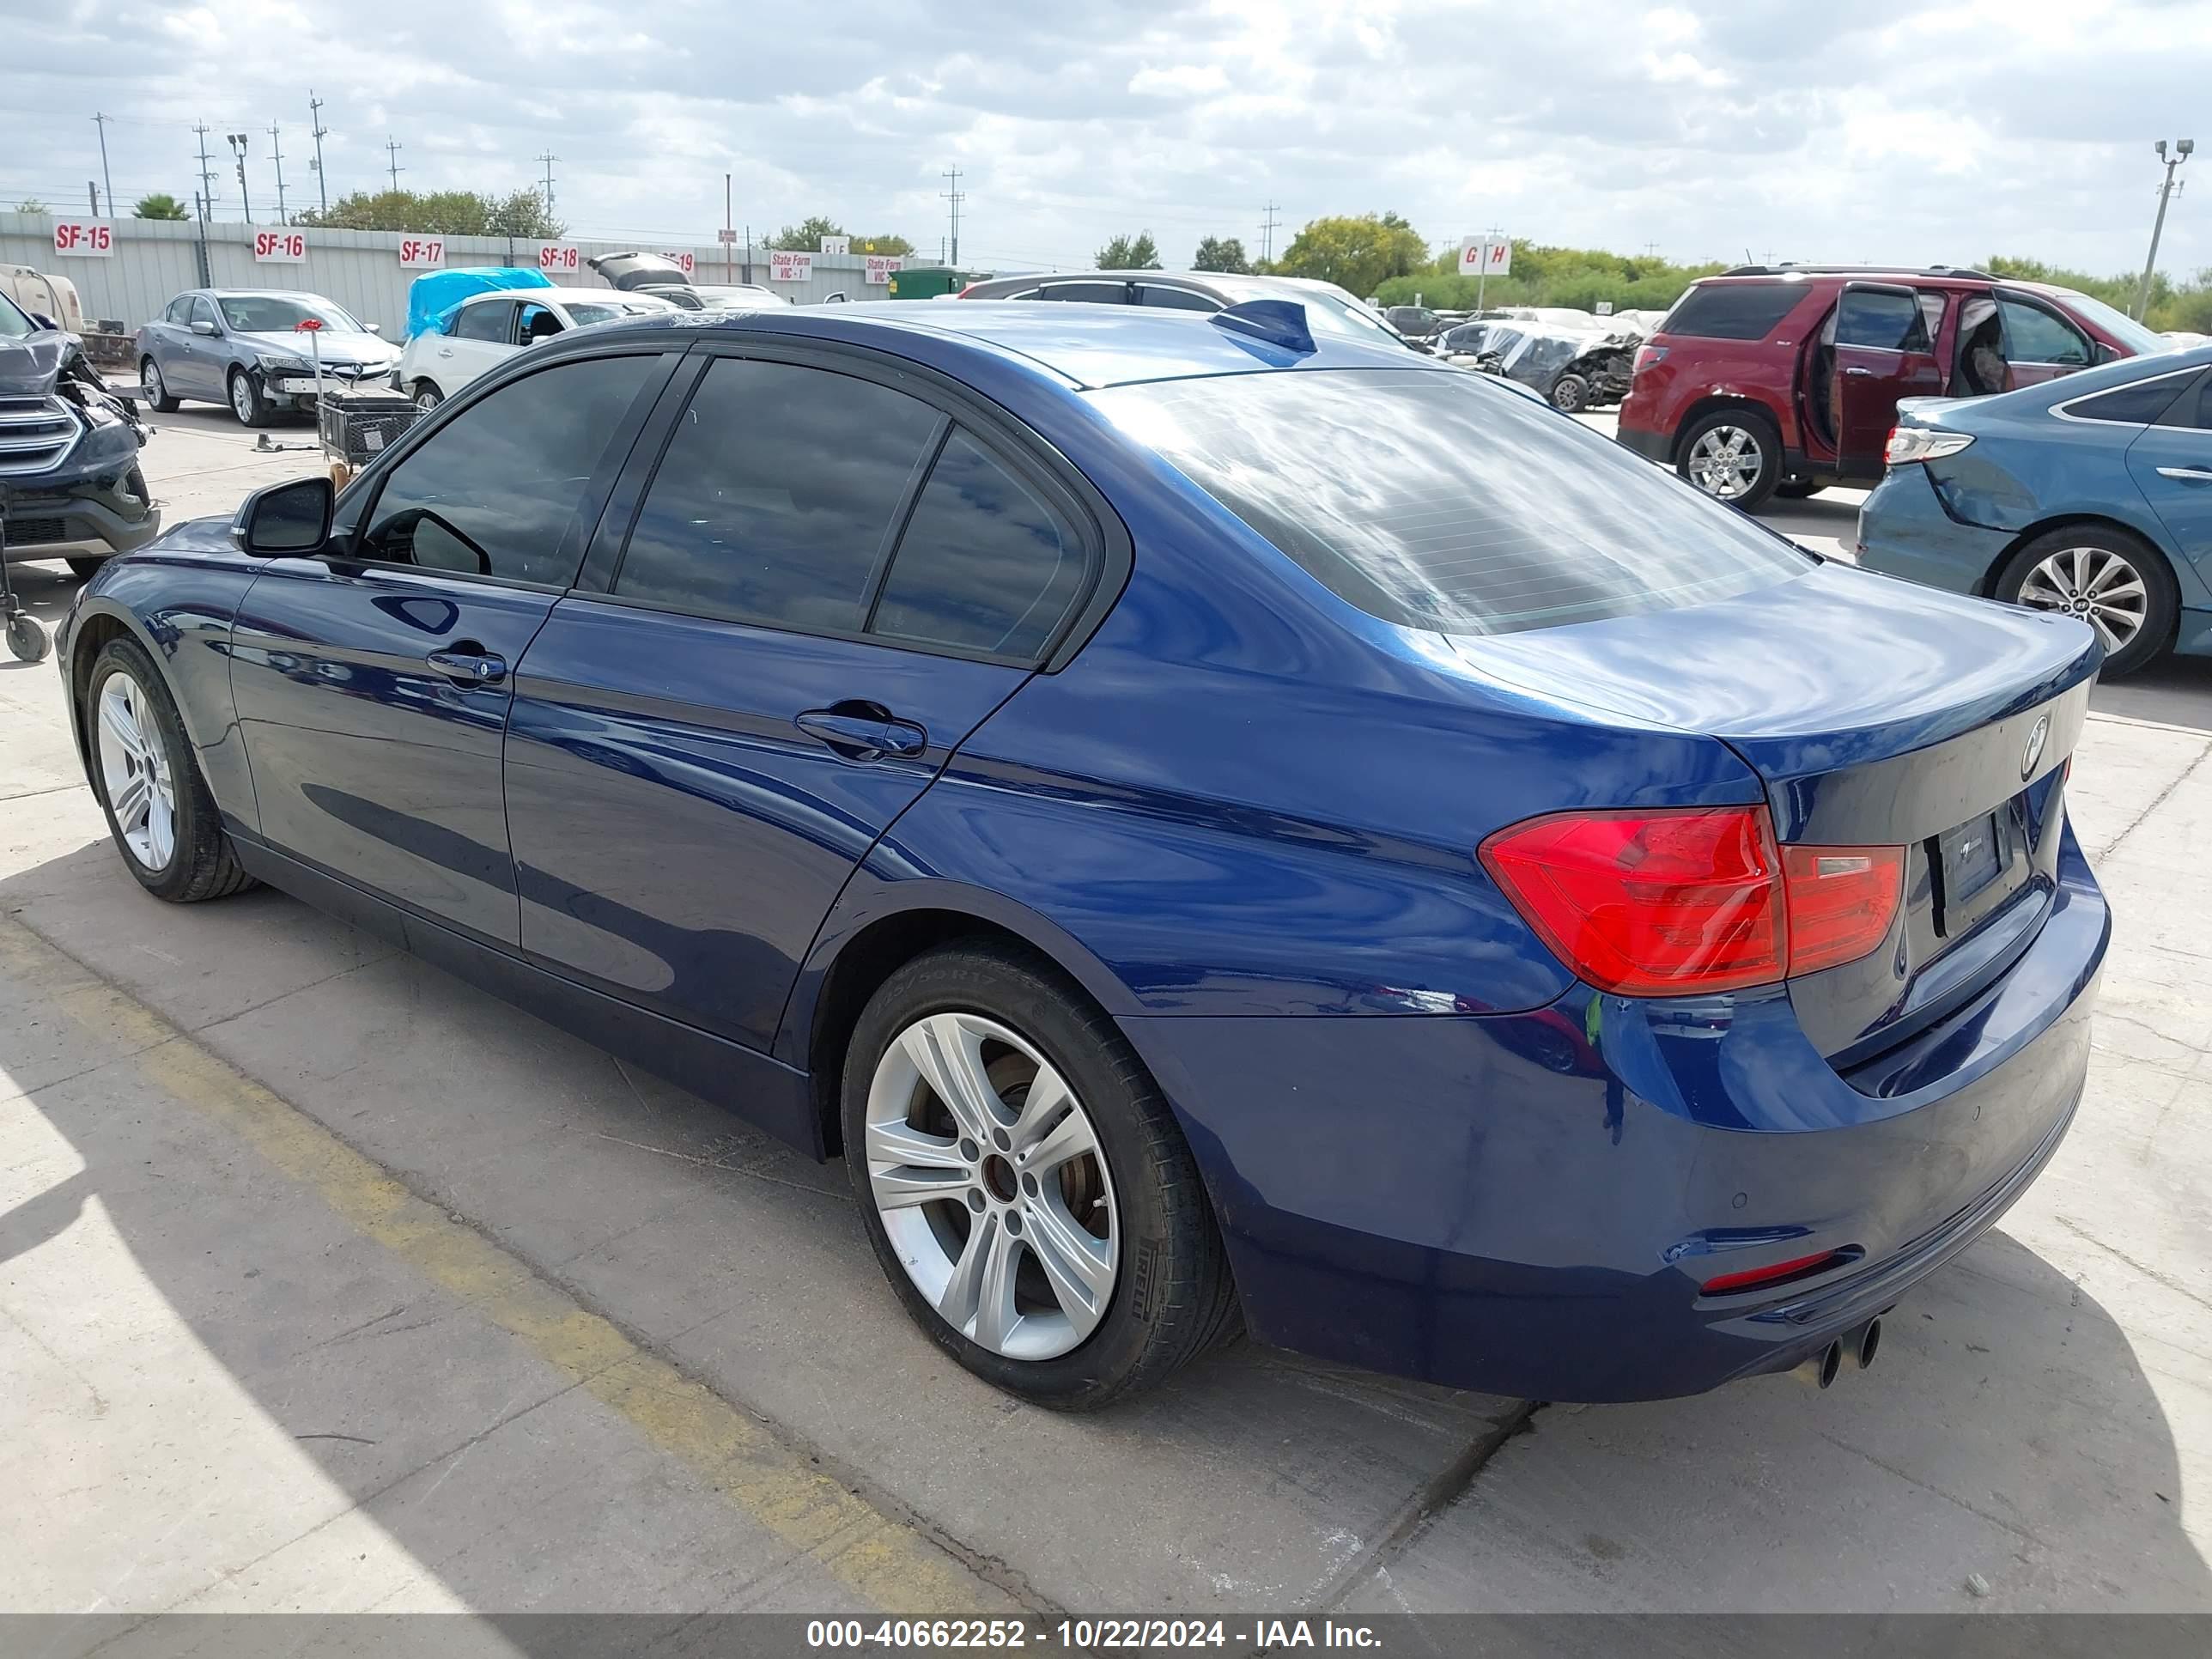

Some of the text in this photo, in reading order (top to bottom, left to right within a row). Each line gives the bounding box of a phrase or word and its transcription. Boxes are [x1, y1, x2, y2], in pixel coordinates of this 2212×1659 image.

[57, 225, 109, 249] SF-15
[257, 234, 302, 256] SF-16
[402, 241, 441, 261] SF-17
[541, 247, 576, 267] SF-18
[772, 253, 811, 266] State Farm
[1467, 246, 1477, 263] G
[1492, 246, 1504, 263] H
[867, 258, 901, 270] State Farm
[781, 267, 792, 278] VIC
[799, 269, 803, 279] 1
[874, 270, 885, 282] VIC
[1132, 1237, 1159, 1322] PIRELLI
